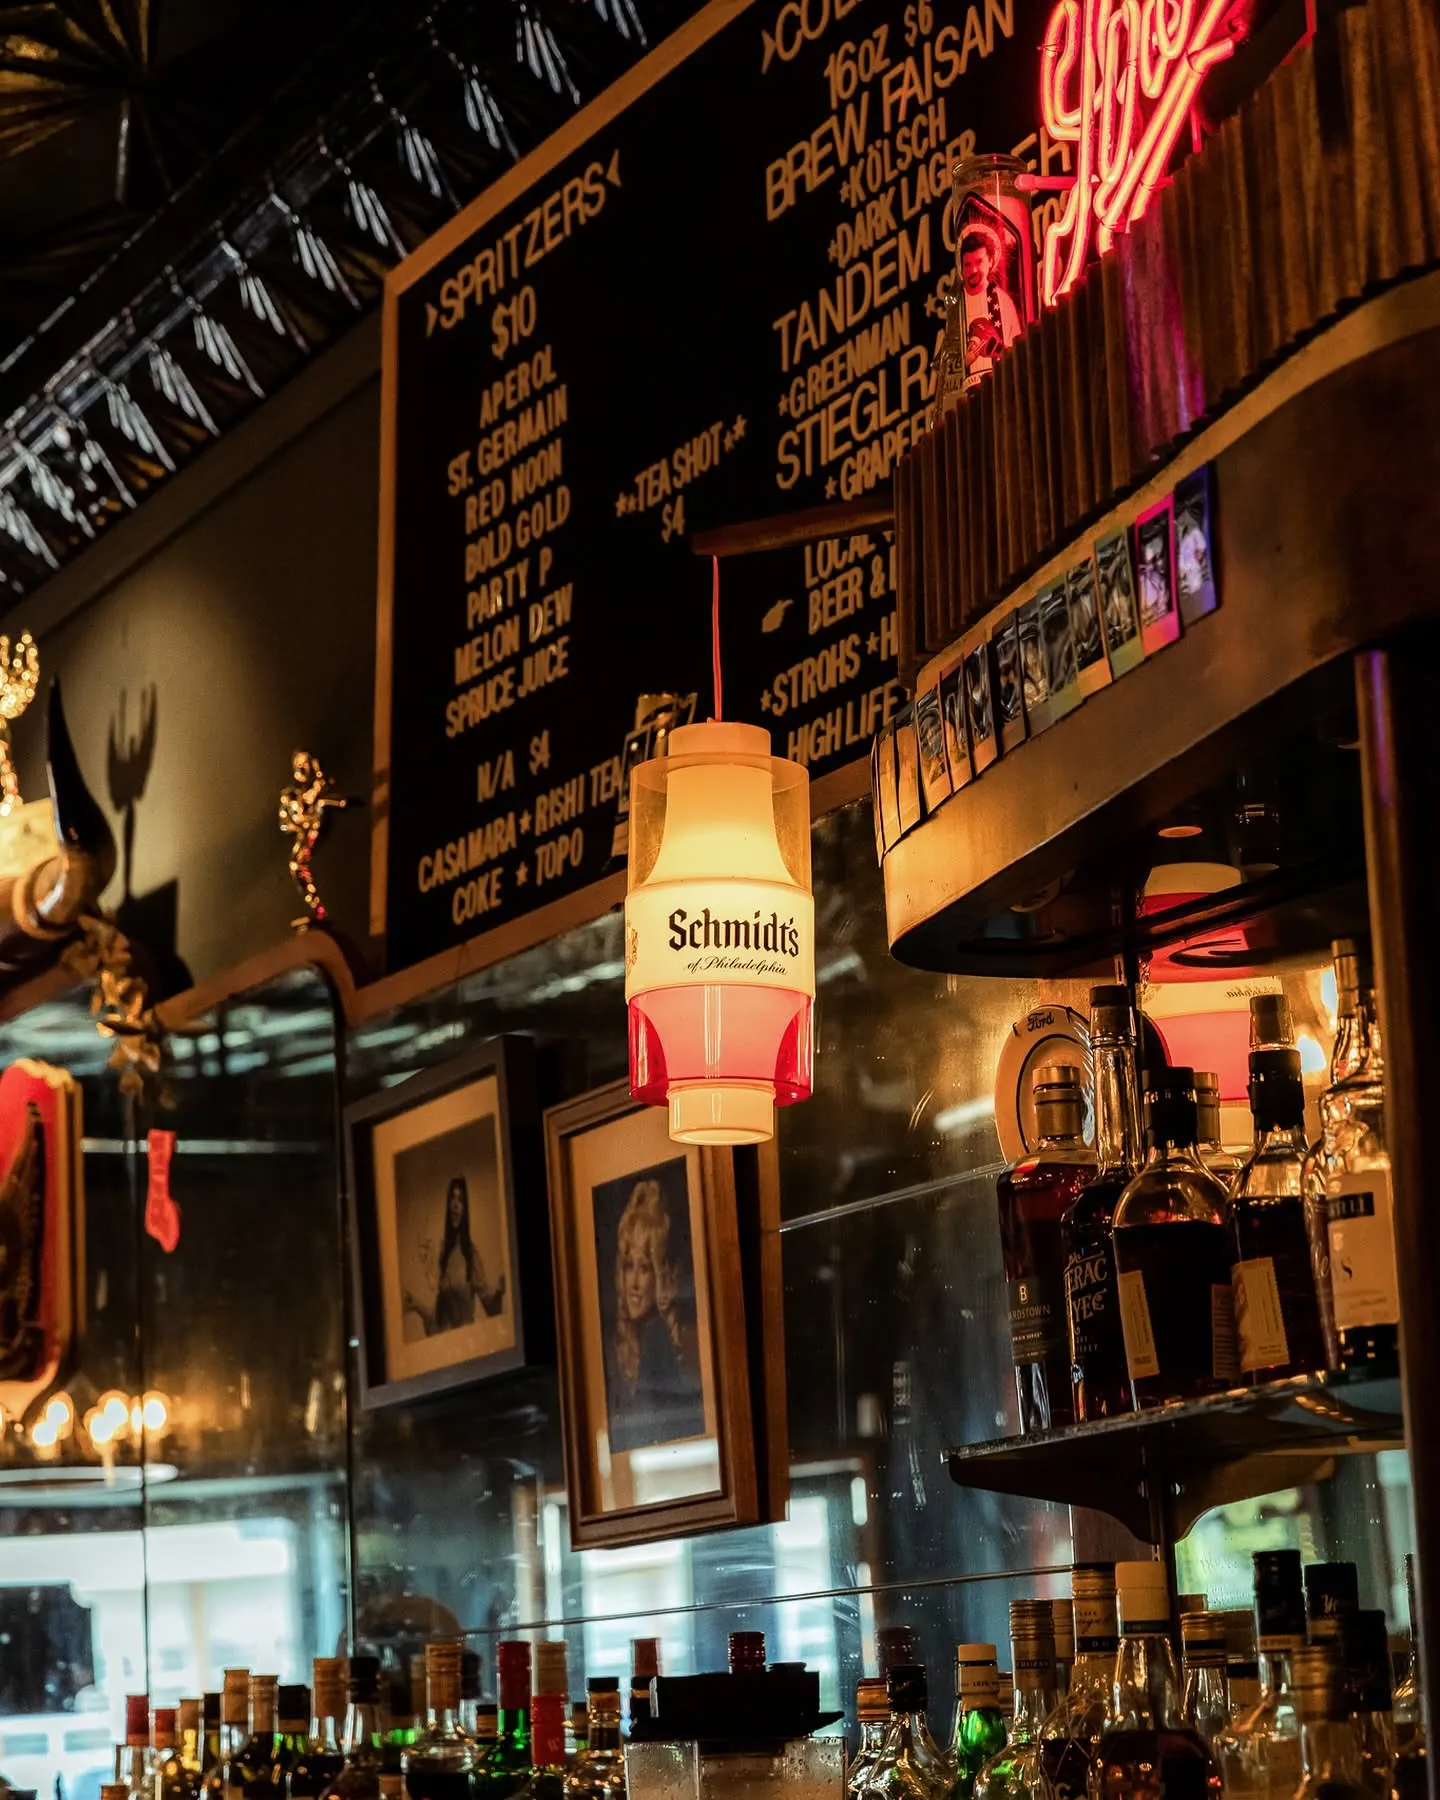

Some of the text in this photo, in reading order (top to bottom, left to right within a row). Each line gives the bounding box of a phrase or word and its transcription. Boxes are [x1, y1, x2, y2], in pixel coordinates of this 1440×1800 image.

[765, 90, 869, 222] BREW
[849, 97, 946, 208] KÖLSCH
[439, 162, 606, 329] SPRITZERS
[836, 187, 897, 269] DARK
[491, 285, 537, 359] $10
[772, 213, 931, 372] TANDEM
[480, 345, 557, 429] APEROL
[789, 302, 910, 419] GREENMAN
[448, 383, 568, 496] ST. GERMAIN
[634, 420, 724, 512] TEA SHOT
[465, 479, 505, 535] RED
[465, 485, 570, 583] BOLD GOLD
[661, 495, 685, 543] $4
[467, 546, 553, 630] PARTY P
[808, 566, 863, 636] BEER
[870, 554, 886, 599] &
[454, 582, 574, 686] MELON DEW
[772, 633, 861, 717] STROHS
[445, 635, 570, 738] SPRUCE JUICE
[788, 678, 898, 766] HIGH LIFE
[477, 729, 551, 803] N/A $4
[418, 755, 623, 894] CASAMARA RISHI TEA
[452, 827, 584, 925] COKE TOPO
[669, 907, 799, 958] Schmidt's
[687, 956, 788, 976] of Philadelphia
[1027, 1012, 1055, 1032] Ford
